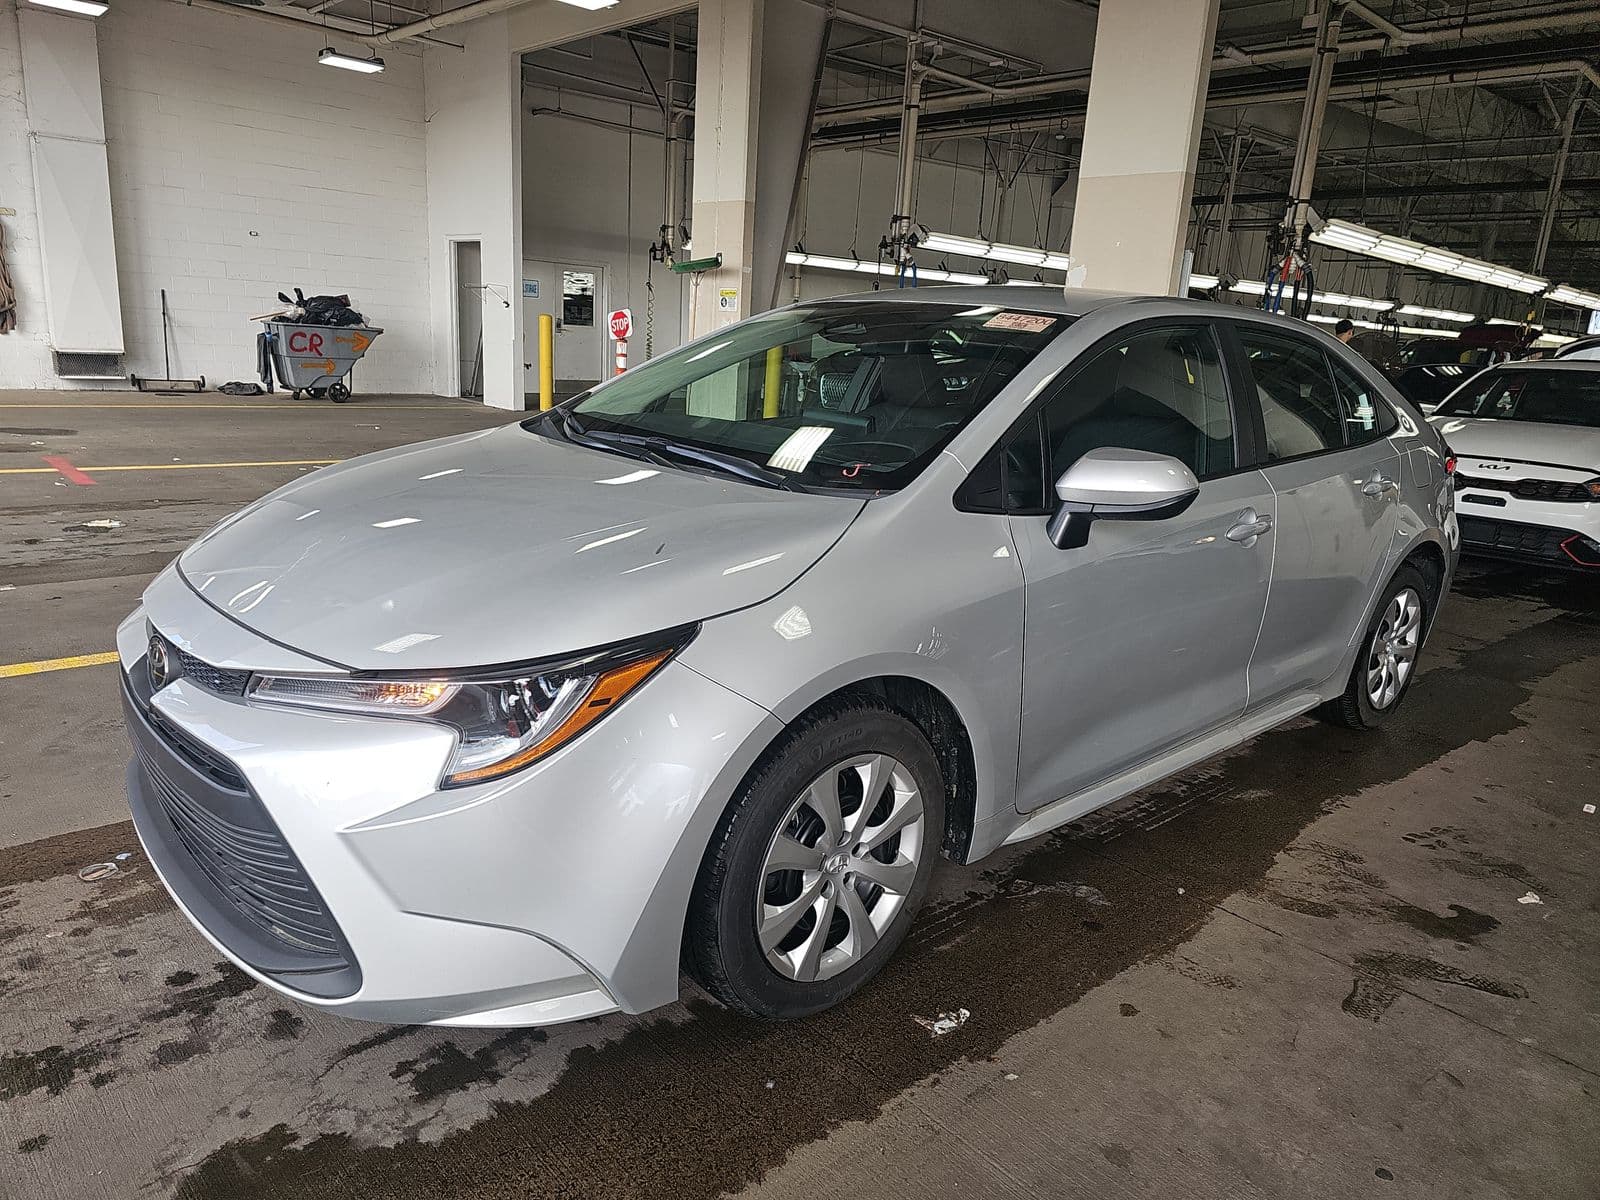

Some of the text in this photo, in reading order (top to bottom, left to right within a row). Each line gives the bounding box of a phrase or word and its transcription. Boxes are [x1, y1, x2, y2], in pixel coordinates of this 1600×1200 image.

[611, 317, 629, 332] STOP
[289, 331, 323, 356] CR
[1478, 463, 1510, 471] KIA
